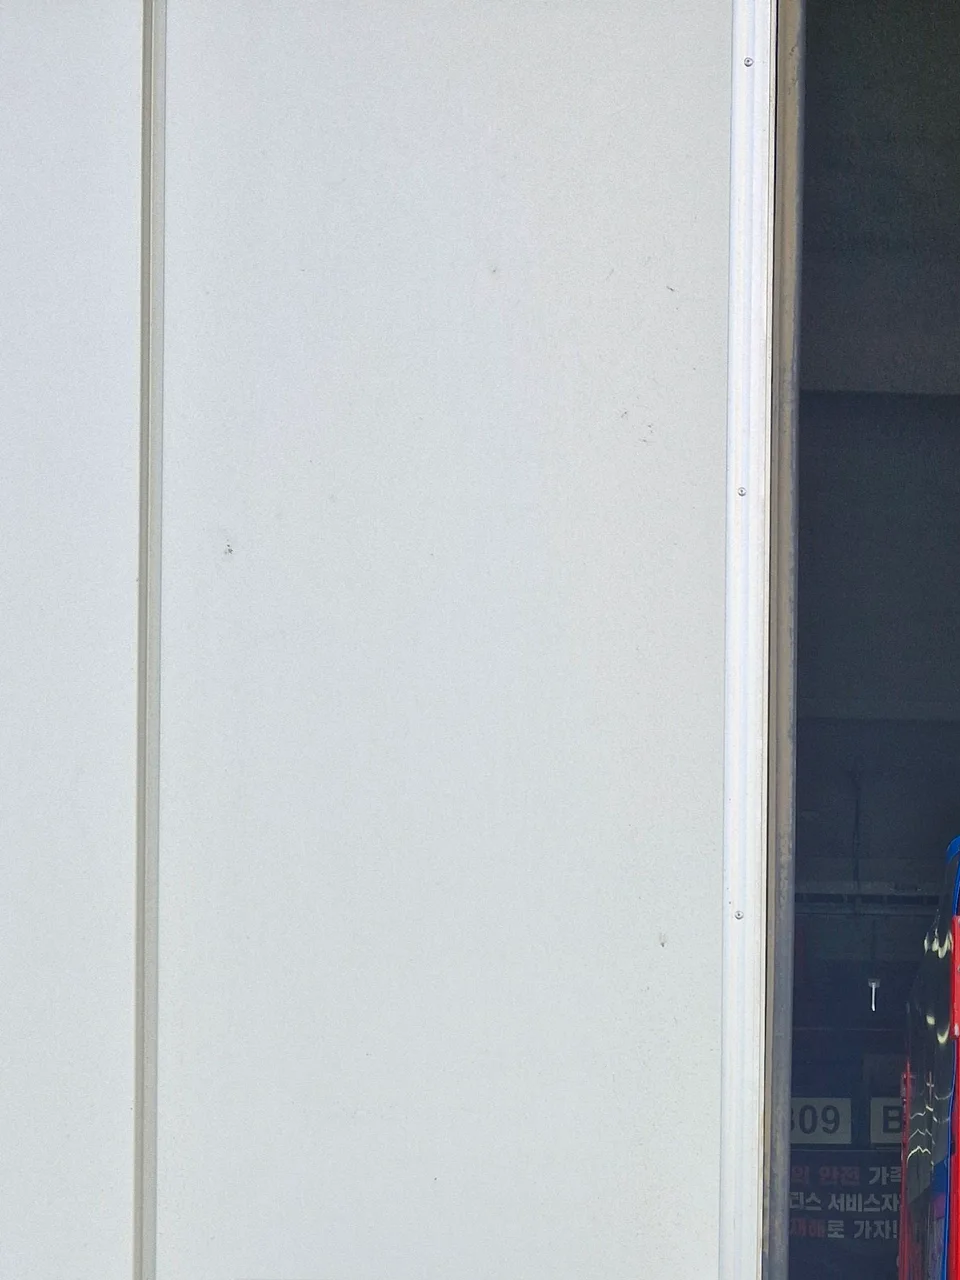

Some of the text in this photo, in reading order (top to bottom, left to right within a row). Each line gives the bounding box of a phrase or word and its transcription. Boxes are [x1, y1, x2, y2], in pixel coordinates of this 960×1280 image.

[819, 1165, 860, 1187] 안전
[827, 1192, 901, 1213] 서비스자
[853, 1219, 898, 1240] 가자!
